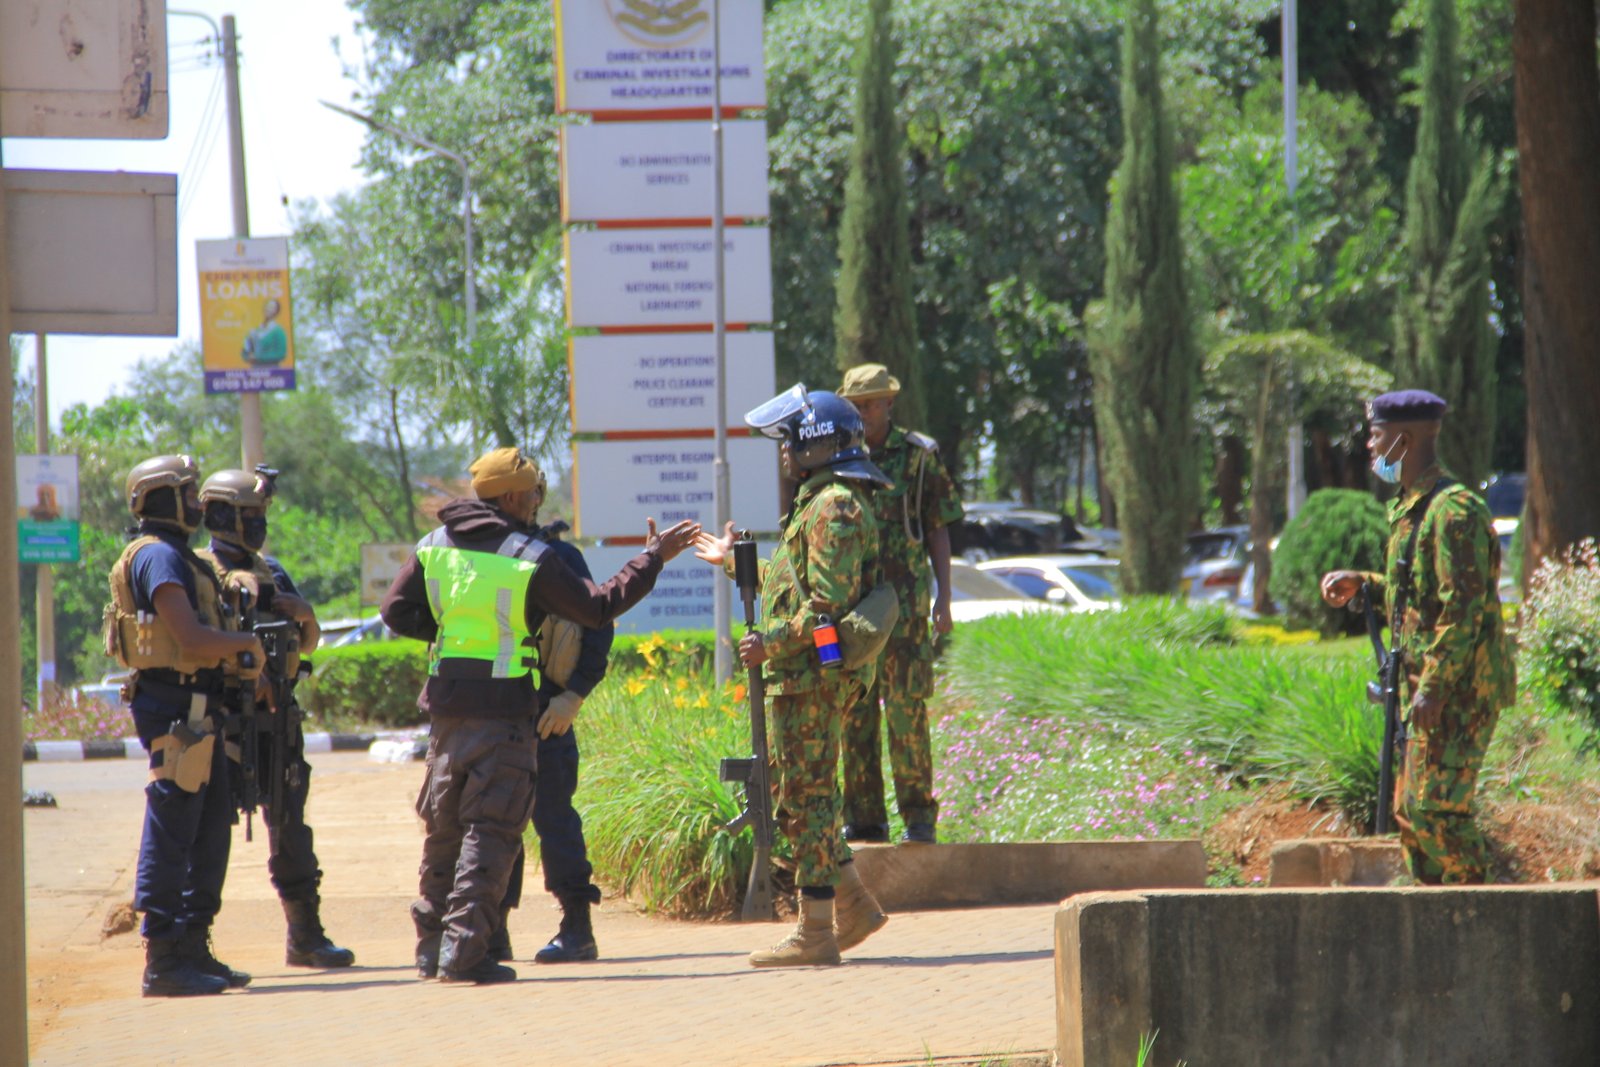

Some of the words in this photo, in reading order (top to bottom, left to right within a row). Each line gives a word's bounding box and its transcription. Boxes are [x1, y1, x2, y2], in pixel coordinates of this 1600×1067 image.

[606, 50, 695, 63] DIRECTORATE
[573, 69, 637, 82] CRIMINAL
[611, 85, 713, 99] HEADQUARTER
[651, 260, 689, 272] BUREAU
[206, 280, 284, 300] LOANS
[625, 282, 672, 294] NATIONAL
[798, 421, 835, 441] POLICE
[660, 471, 698, 483] BUREAU
[636, 493, 683, 505] NATIONAL
